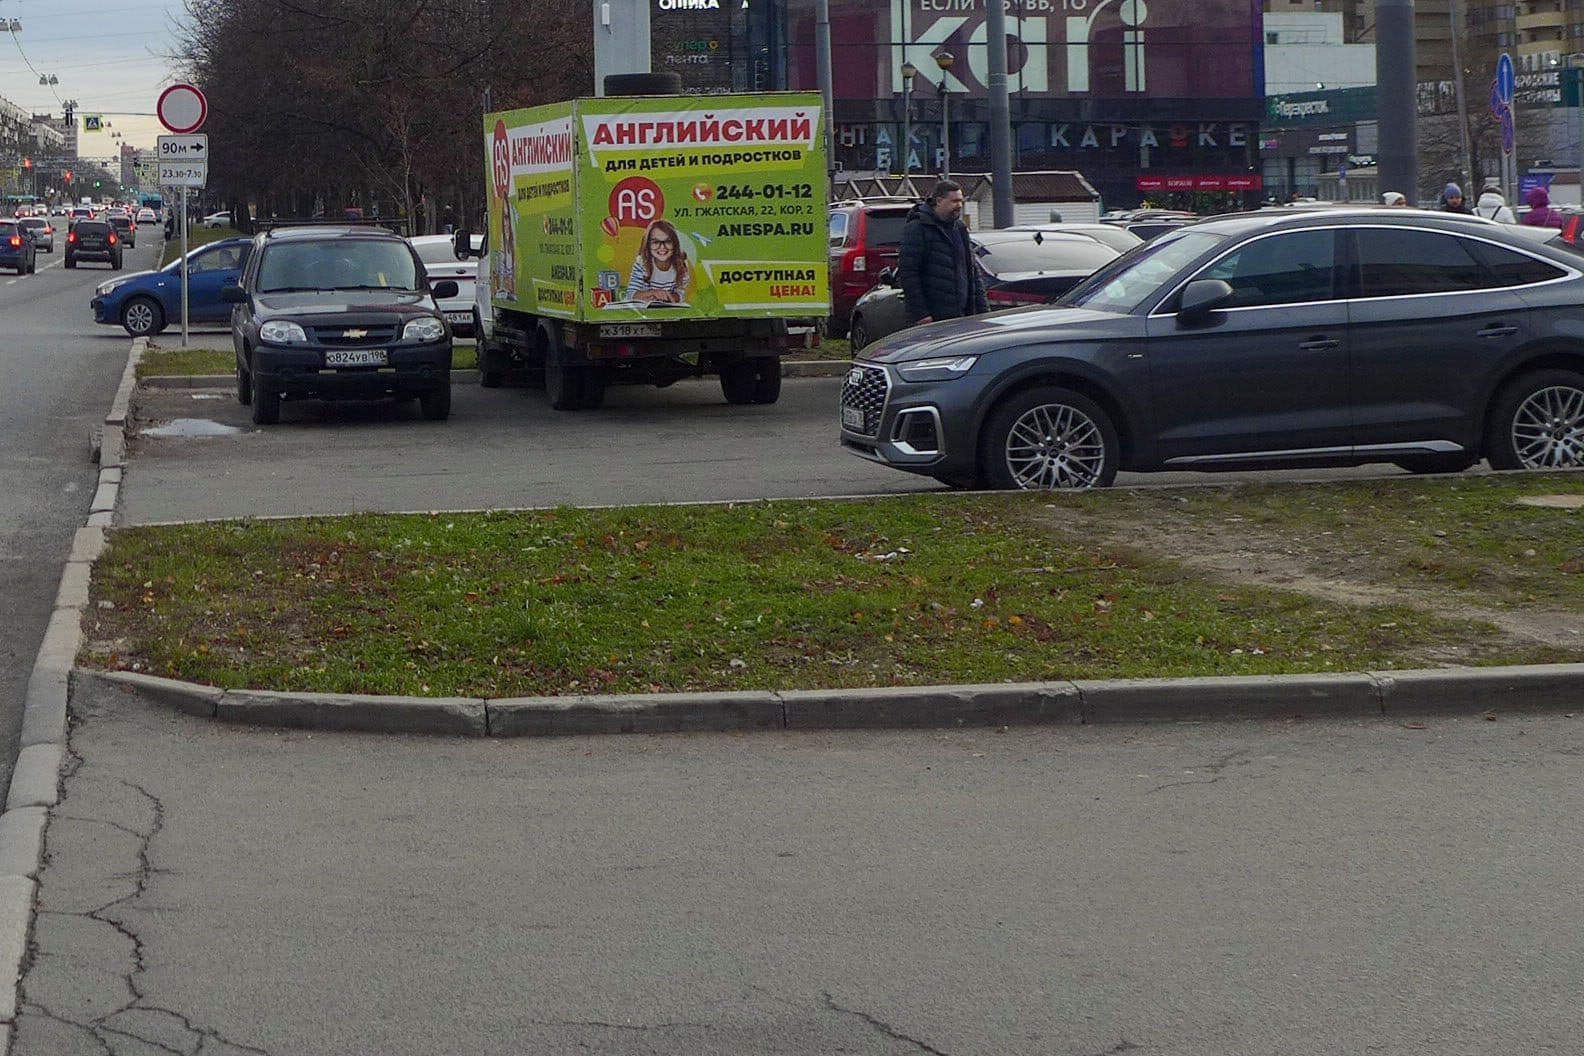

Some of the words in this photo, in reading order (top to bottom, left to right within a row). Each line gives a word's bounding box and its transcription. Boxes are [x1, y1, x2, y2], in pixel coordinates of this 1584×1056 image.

[592, 112, 811, 145] АНГЛИЙСКИЙ
[162, 142, 187, 154] 90м
[512, 124, 572, 166] АНГЛИЙСКИЙ
[605, 159, 636, 173] ДЛЯ
[639, 154, 686, 170] ДЕТЕЙ
[689, 155, 699, 166] И
[702, 150, 802, 166] ПОДРОСТКОВ
[716, 184, 813, 200] 244-01-12
[617, 188, 656, 220] AS
[674, 207, 692, 218] УЛ.
[695, 206, 757, 218] ГЖАТСКАЯ,
[760, 206, 777, 217] 22,
[780, 205, 804, 216] КОР.
[807, 205, 813, 214] 2
[717, 222, 814, 237] ANESPA.RU
[607, 274, 617, 288] B
[719, 269, 816, 284] ДОСТУПНАЯ
[769, 285, 816, 298] ЦЕНА!
[597, 293, 608, 306] A
